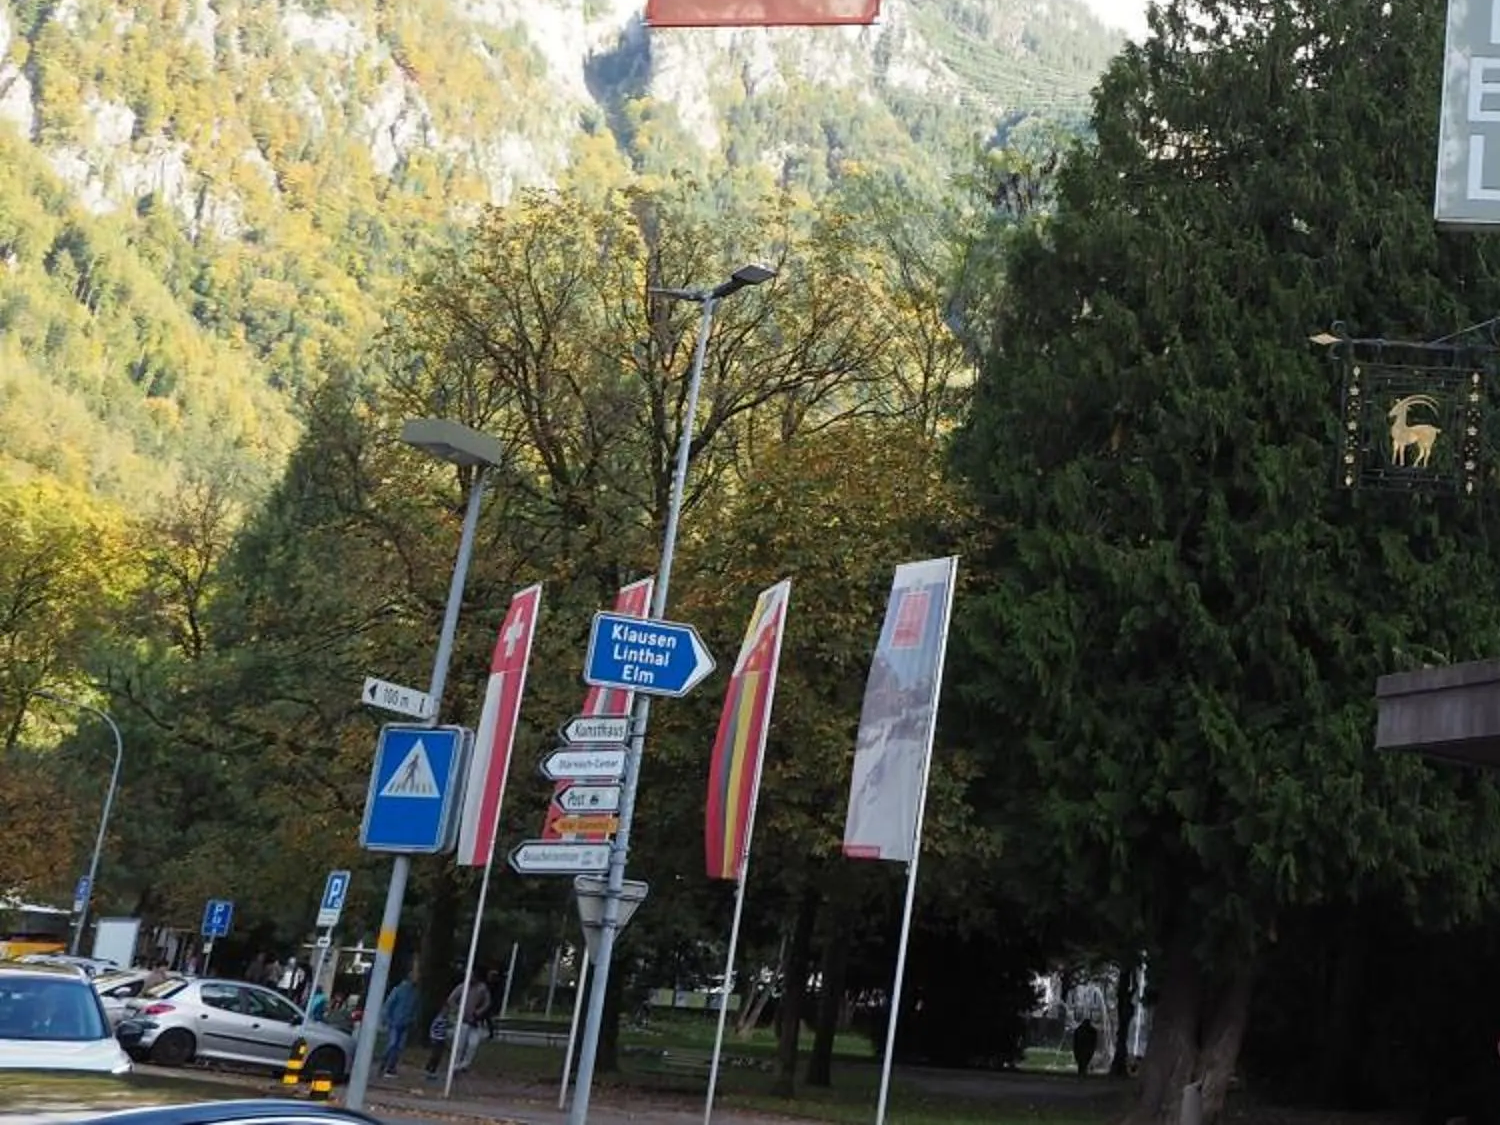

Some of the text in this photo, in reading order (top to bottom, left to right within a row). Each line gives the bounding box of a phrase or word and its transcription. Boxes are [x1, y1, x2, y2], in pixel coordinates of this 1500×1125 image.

[611, 623, 678, 650] Klausen
[613, 643, 671, 667] Linthal
[622, 664, 655, 684] Elm
[574, 722, 625, 738] Kunsthaus
[567, 790, 585, 807] Post
